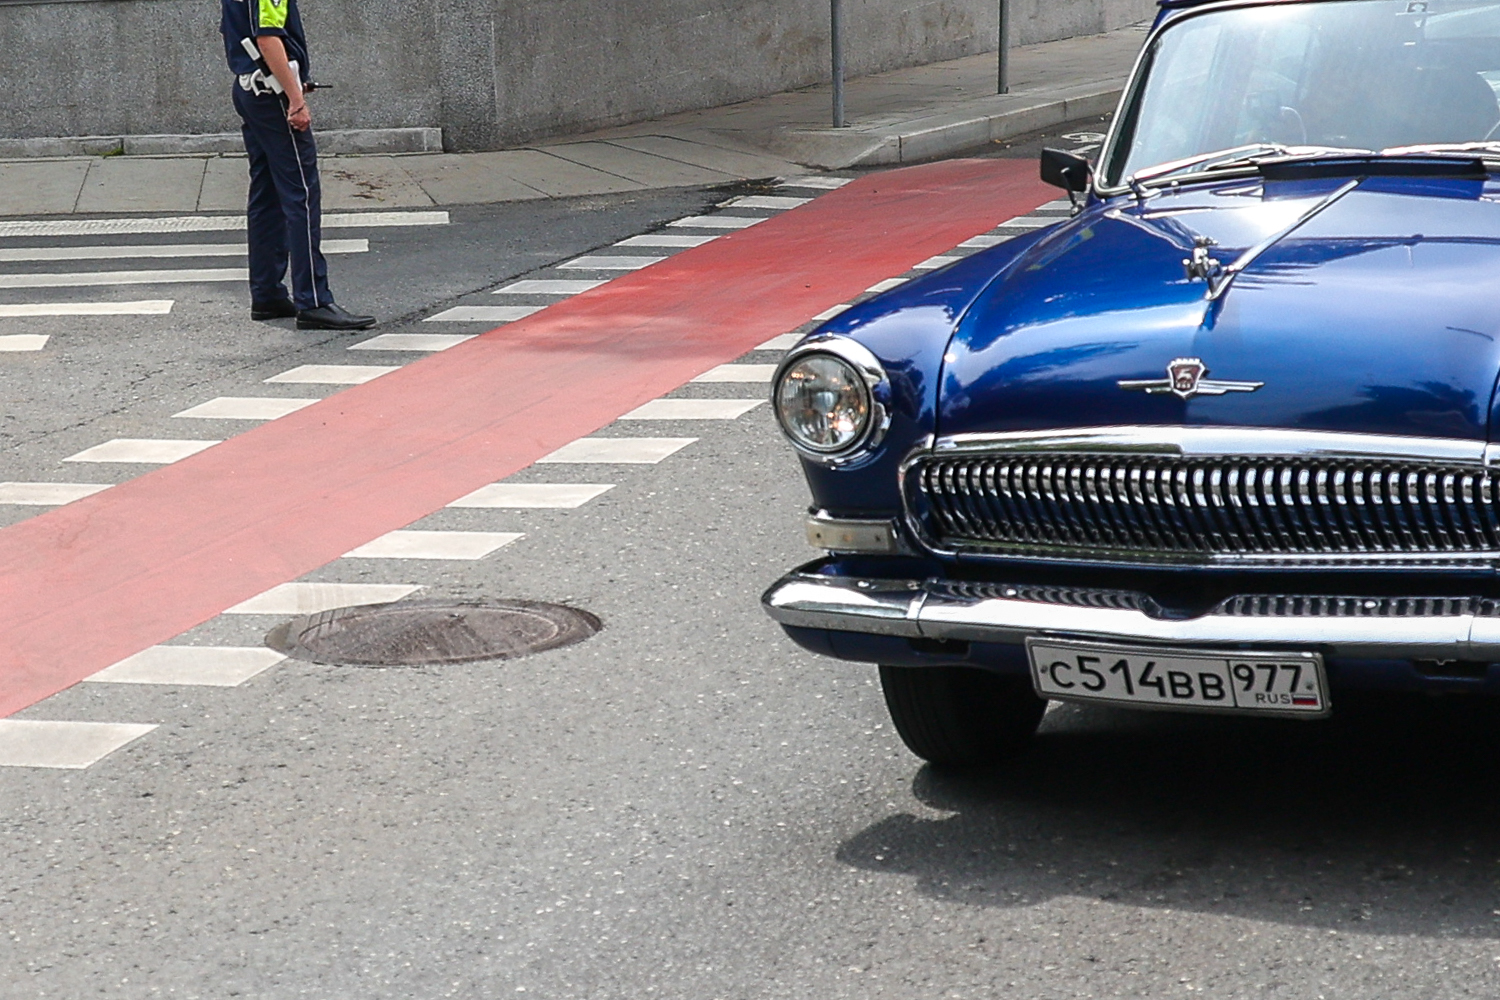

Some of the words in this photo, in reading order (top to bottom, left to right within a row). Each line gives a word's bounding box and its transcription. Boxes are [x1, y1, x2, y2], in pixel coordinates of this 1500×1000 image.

[1049, 655, 1226, 701] С514ВВ
[1233, 664, 1302, 693] 977
[1255, 692, 1291, 705] RUS
